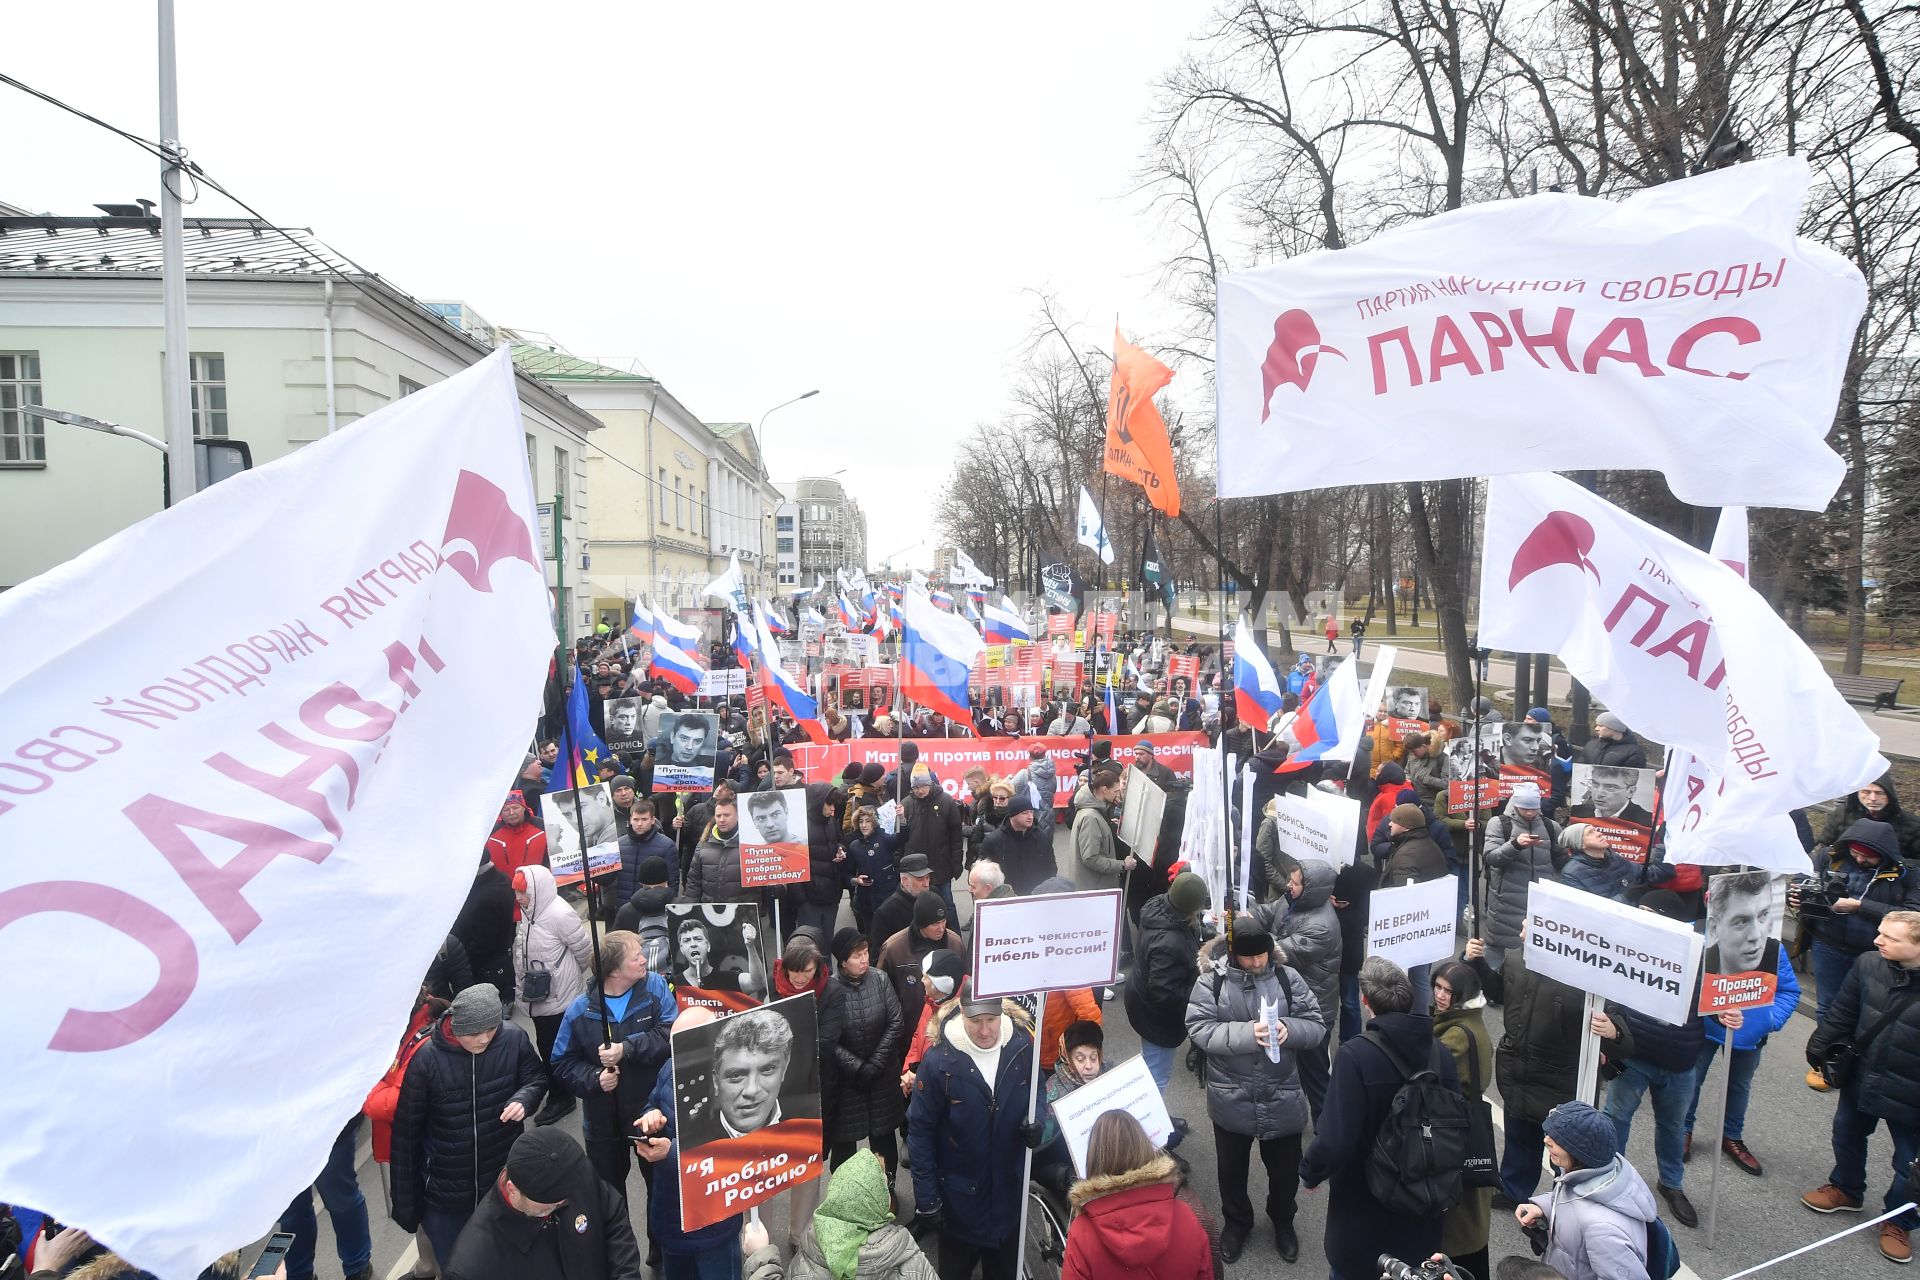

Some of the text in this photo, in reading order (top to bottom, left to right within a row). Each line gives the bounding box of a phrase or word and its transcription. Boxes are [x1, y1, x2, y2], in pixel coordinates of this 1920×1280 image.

[1357, 283, 1435, 320] ПАРТИЯ
[1600, 258, 1787, 302] СВОБОДЫ
[1367, 306, 1762, 396] ПАРНАС
[608, 739, 643, 751] БОРИСЬ
[933, 750, 991, 768] против
[1277, 811, 1328, 841] БОРИСЬ против
[1594, 826, 1639, 836] утинский
[744, 847, 774, 857] “Путин
[1302, 835, 1329, 854] ПРАВДУ
[745, 855, 782, 865] пытается
[745, 864, 783, 874] отобрать
[746, 875, 751, 884] у
[753, 874, 767, 882] нас
[1374, 909, 1430, 932] НЕ ВЕРИМ
[985, 936, 1034, 947] Власть
[1373, 922, 1452, 949] ТЕЛЕПРОПАГАНДЕ
[1533, 914, 1683, 974] БОРИСЬ ПРОТИВ
[984, 940, 1107, 964] гибель России!
[1532, 932, 1681, 996] ВЫМИРАНИЯ
[1712, 995, 1726, 1007] за
[1464, 1156, 1492, 1168] rginem
[705, 1152, 789, 1196] люблю
[724, 1153, 819, 1207] Россию”
